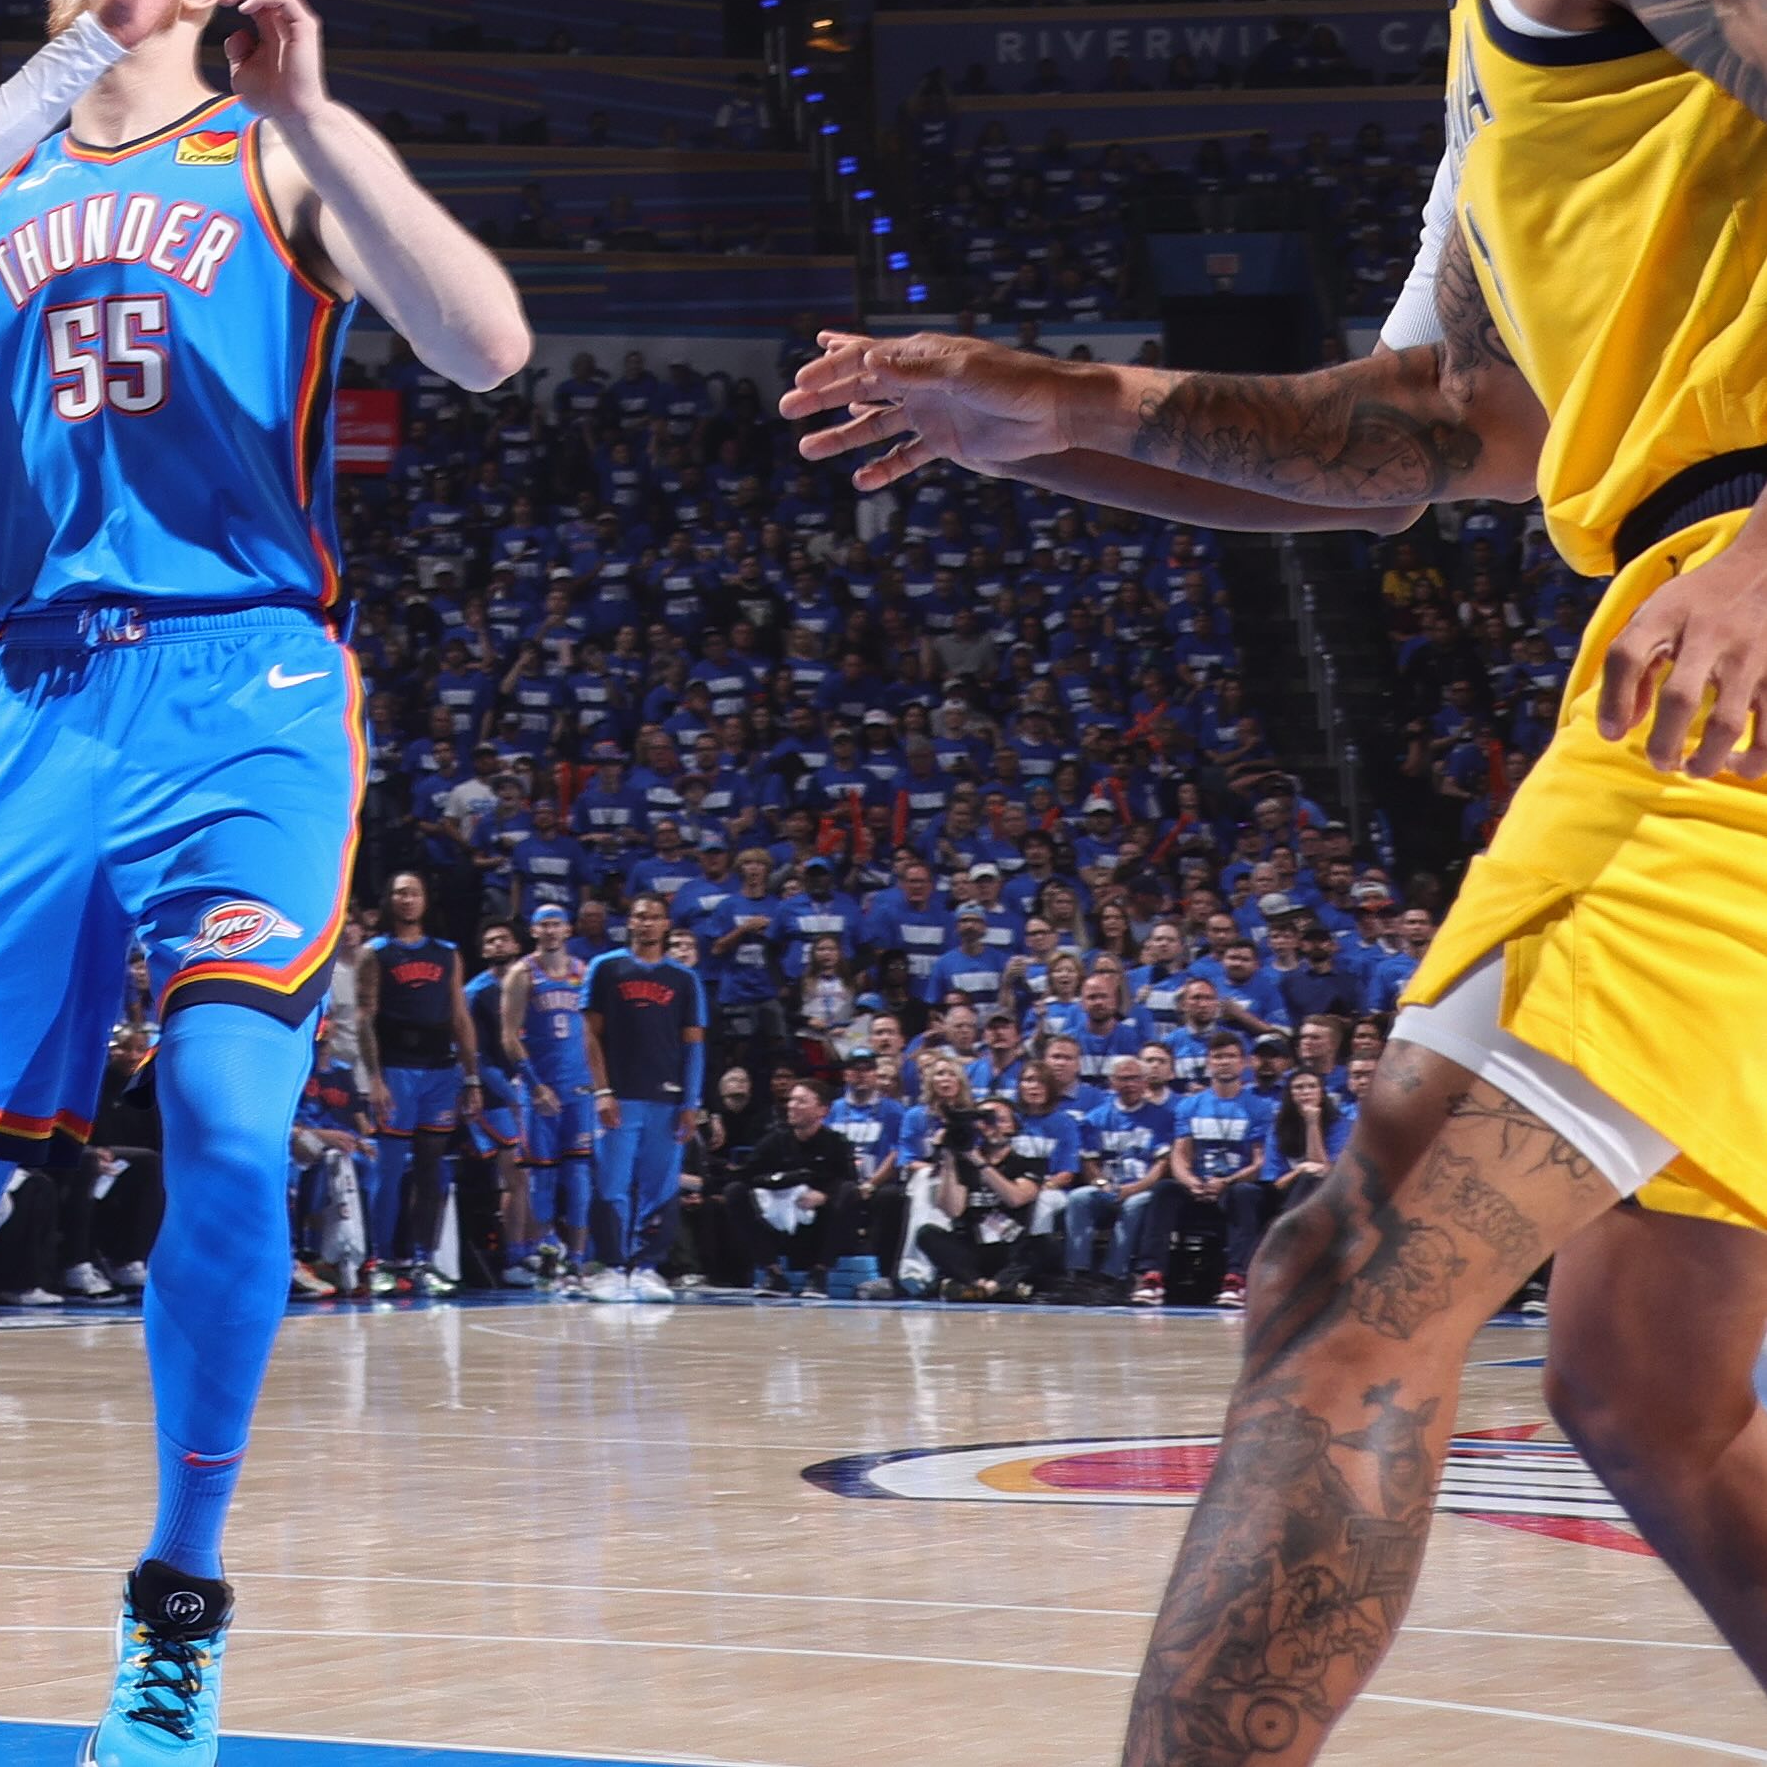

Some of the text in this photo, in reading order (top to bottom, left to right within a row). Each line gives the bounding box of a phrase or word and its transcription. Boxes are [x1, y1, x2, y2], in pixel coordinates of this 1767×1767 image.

[996, 23, 1278, 64] RIVERWI
[44, 293, 170, 424] 55
[553, 1013, 570, 1040] 9
